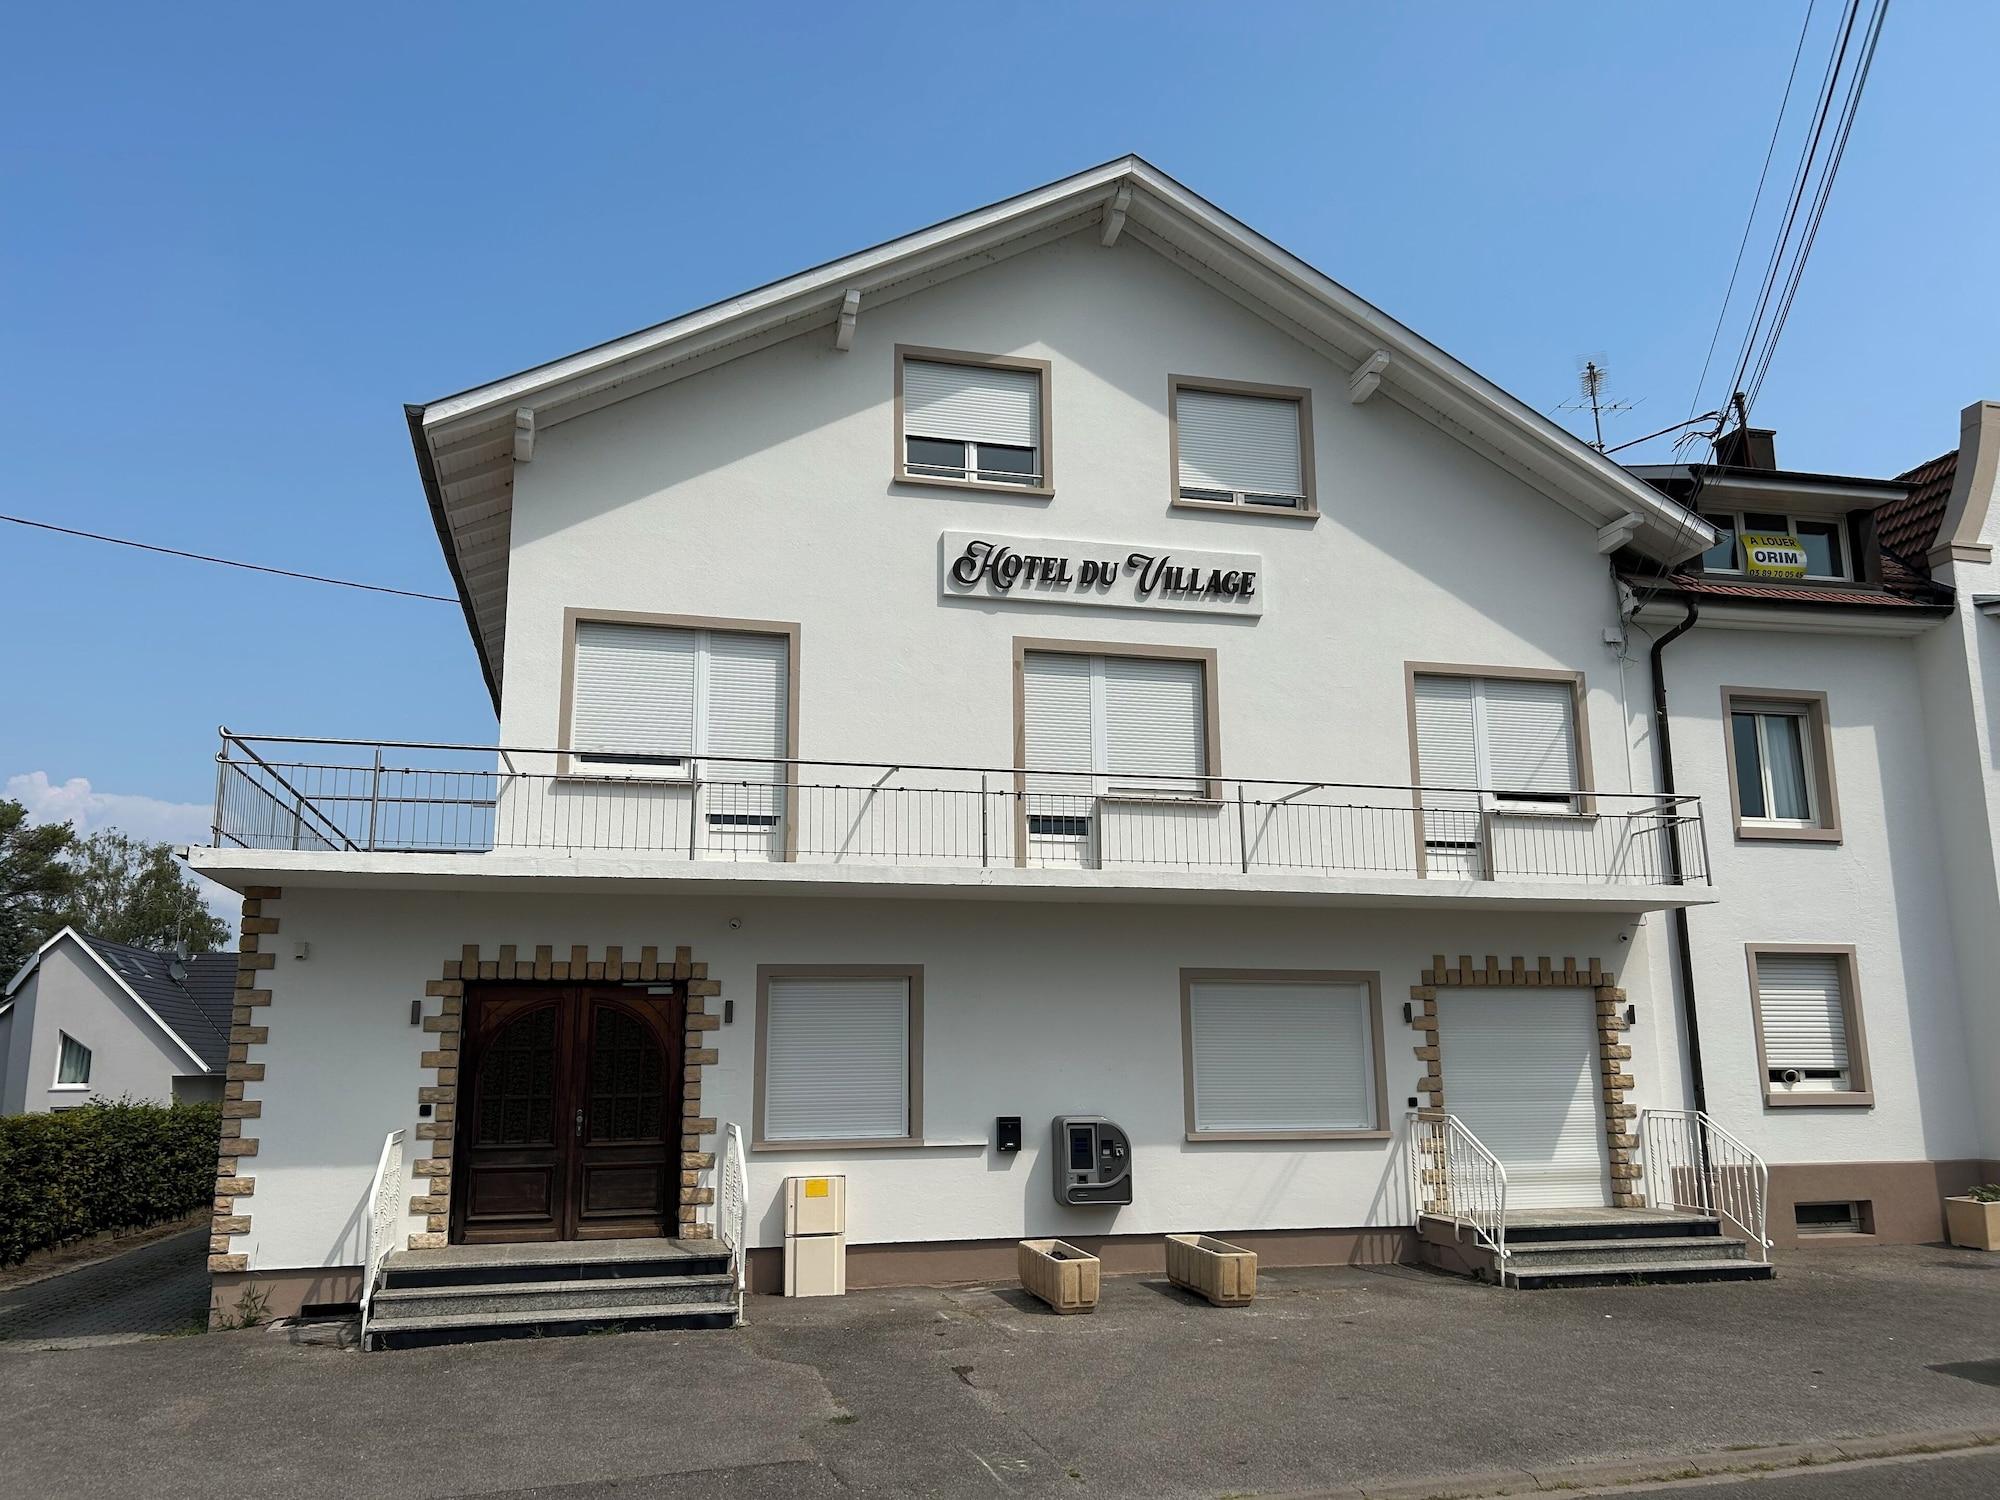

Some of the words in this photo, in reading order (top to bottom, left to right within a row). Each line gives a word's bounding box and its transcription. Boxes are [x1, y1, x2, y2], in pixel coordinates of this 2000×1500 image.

[1751, 537, 1758, 545] A
[1761, 537, 1796, 547] LOUER
[1755, 551, 1798, 564] ORIM
[953, 540, 1073, 589] HOTEL
[1080, 560, 1119, 585] DU
[1128, 552, 1256, 595] VILLAGE
[1750, 569, 1759, 577] 03
